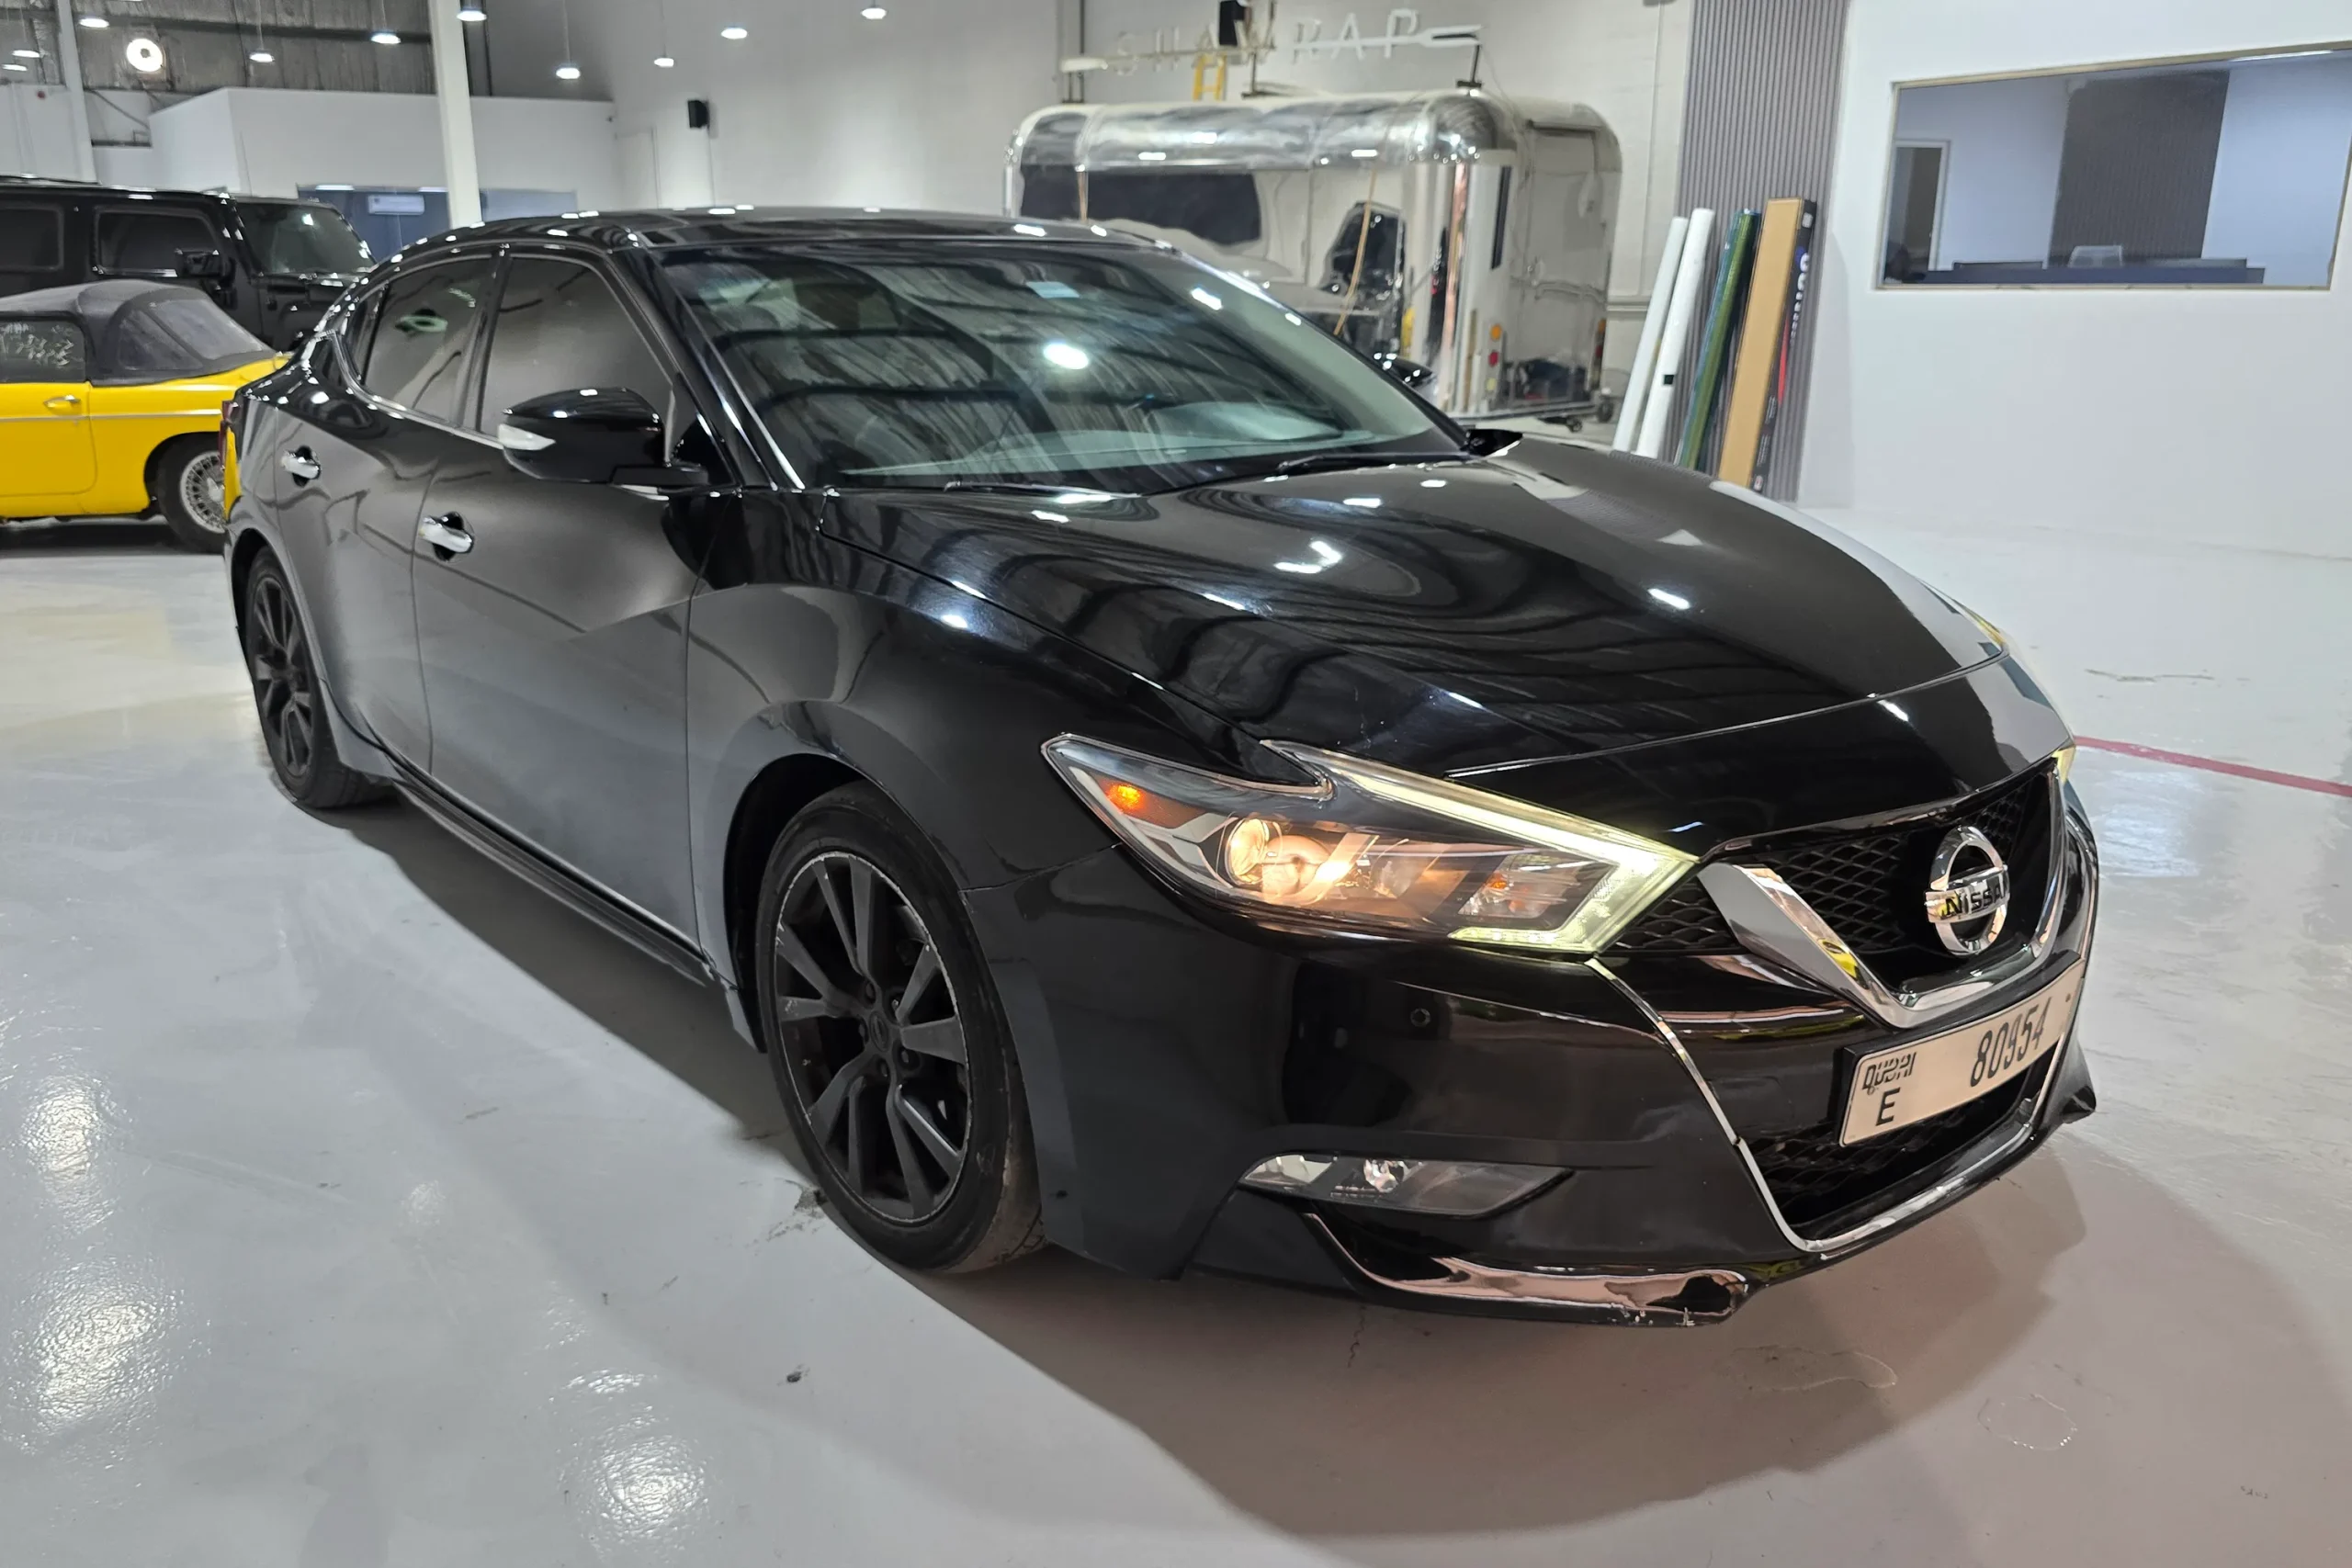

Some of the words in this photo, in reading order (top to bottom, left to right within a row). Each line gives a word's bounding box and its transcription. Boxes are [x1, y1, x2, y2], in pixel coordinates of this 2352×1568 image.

[1943, 878, 2007, 916] NISSA
[1971, 997, 2051, 1087] 80954
[1875, 1087, 1901, 1126] E
